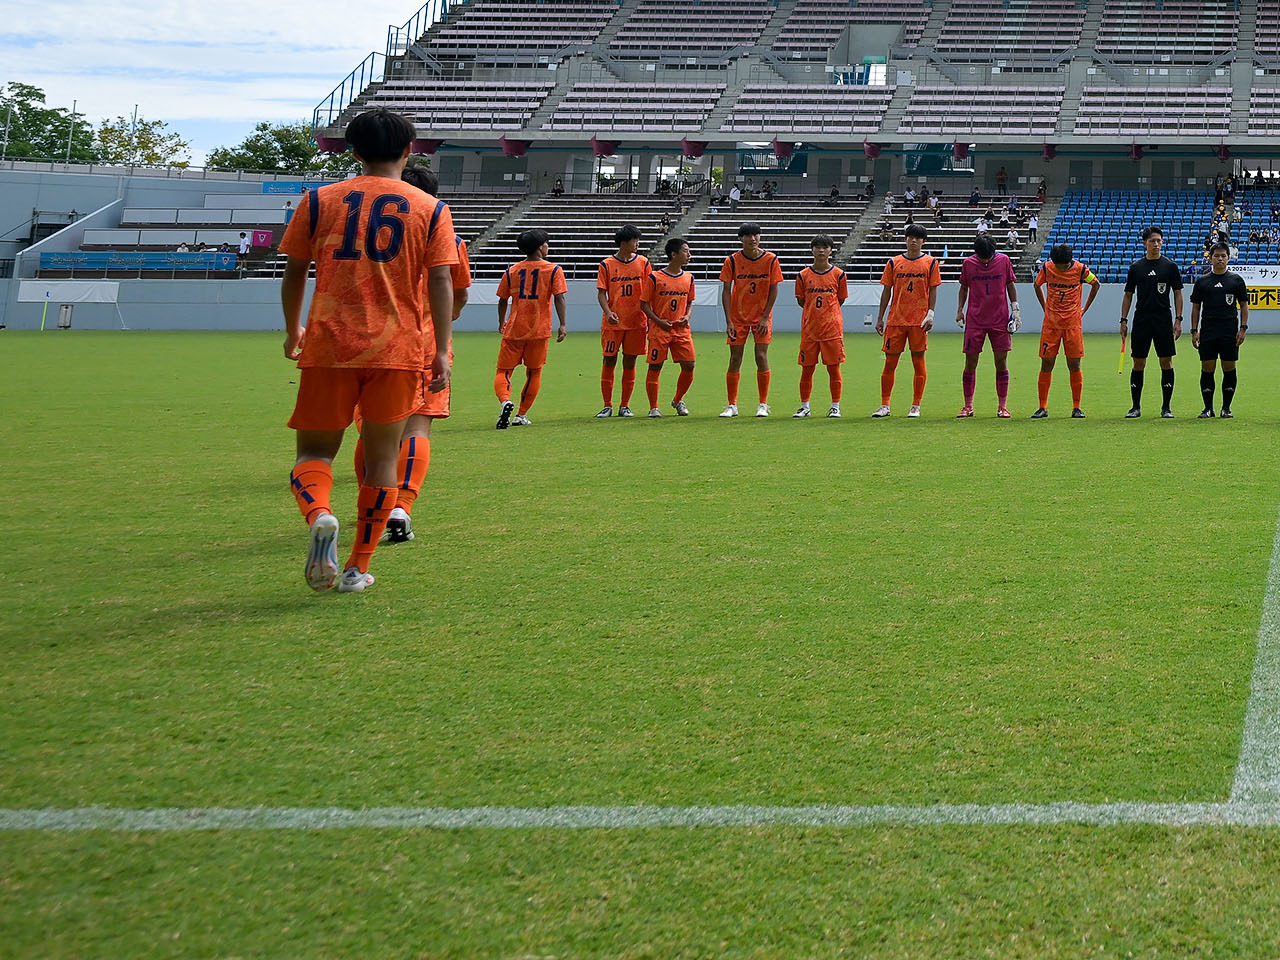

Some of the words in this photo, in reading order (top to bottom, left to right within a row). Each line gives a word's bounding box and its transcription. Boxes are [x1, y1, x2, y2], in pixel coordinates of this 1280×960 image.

[333, 190, 410, 262] 16
[518, 268, 540, 300] 11
[621, 284, 632, 296] 10
[749, 282, 756, 294] 3
[907, 281, 913, 293] 4
[816, 296, 822, 308] 6
[1059, 291, 1066, 302] 7
[670, 299, 677, 312] 9
[605, 341, 615, 353] 10
[1043, 343, 1048, 355] 7
[651, 349, 658, 361] 9
